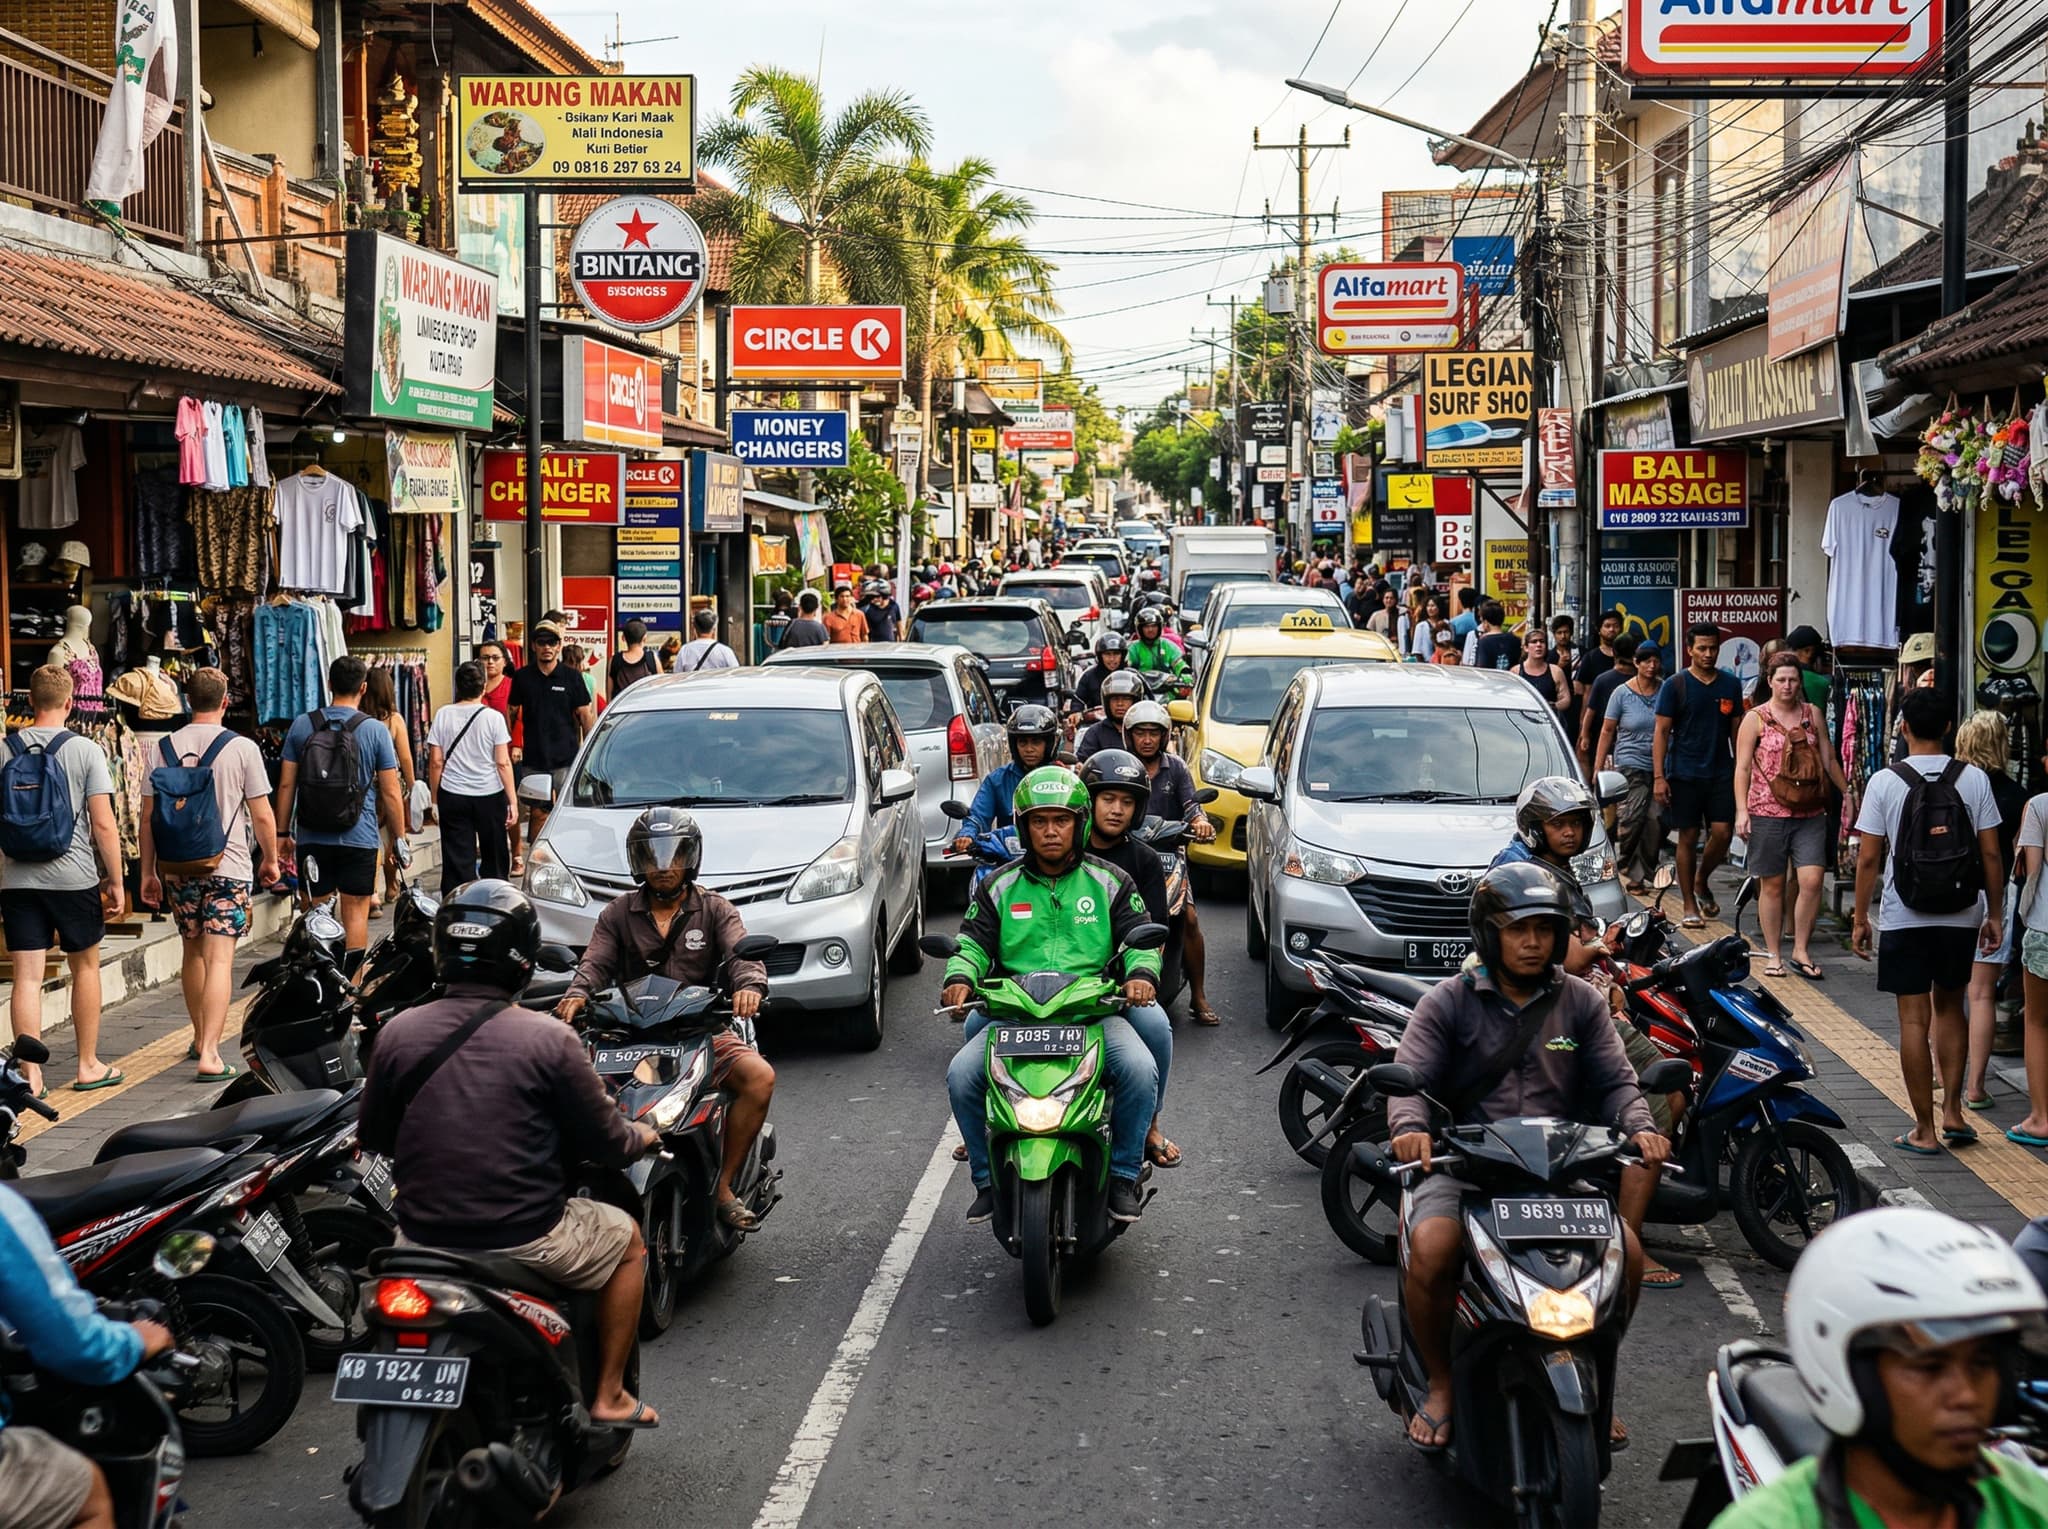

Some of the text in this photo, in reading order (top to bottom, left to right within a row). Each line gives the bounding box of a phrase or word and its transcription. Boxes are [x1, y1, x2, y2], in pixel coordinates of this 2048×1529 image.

[469, 81, 682, 107] WARUNG MAKAN
[612, 111, 638, 123] Kari
[641, 111, 674, 123] Maak
[601, 127, 663, 139] Indonesia
[553, 161, 570, 174] 09
[574, 161, 609, 174] 0816
[613, 161, 638, 174] 297
[664, 161, 682, 174] 24
[582, 254, 693, 277] BINTANG
[401, 255, 491, 323] WARUNG MAKAN
[1333, 276, 1449, 297] Alfamart
[743, 327, 844, 351] CIRCLE
[1430, 356, 1533, 387] LEGIAN
[609, 371, 636, 408] CIRCLE
[1429, 390, 1532, 416] SURF SHO
[754, 418, 825, 436] MONEY
[734, 441, 844, 459] CHANGERS
[1633, 455, 1717, 480] BALI
[490, 480, 611, 504] CHNGER
[1609, 482, 1742, 506] MASSAGE
[1291, 616, 1322, 627] TAXI
[1409, 942, 1466, 959] B 6022
[999, 1030, 1010, 1043] B
[598, 1052, 608, 1063] R
[1499, 1203, 1510, 1220] B
[1521, 1203, 1565, 1220] 9639
[340, 1358, 367, 1379] KB
[376, 1359, 425, 1383] 1924
